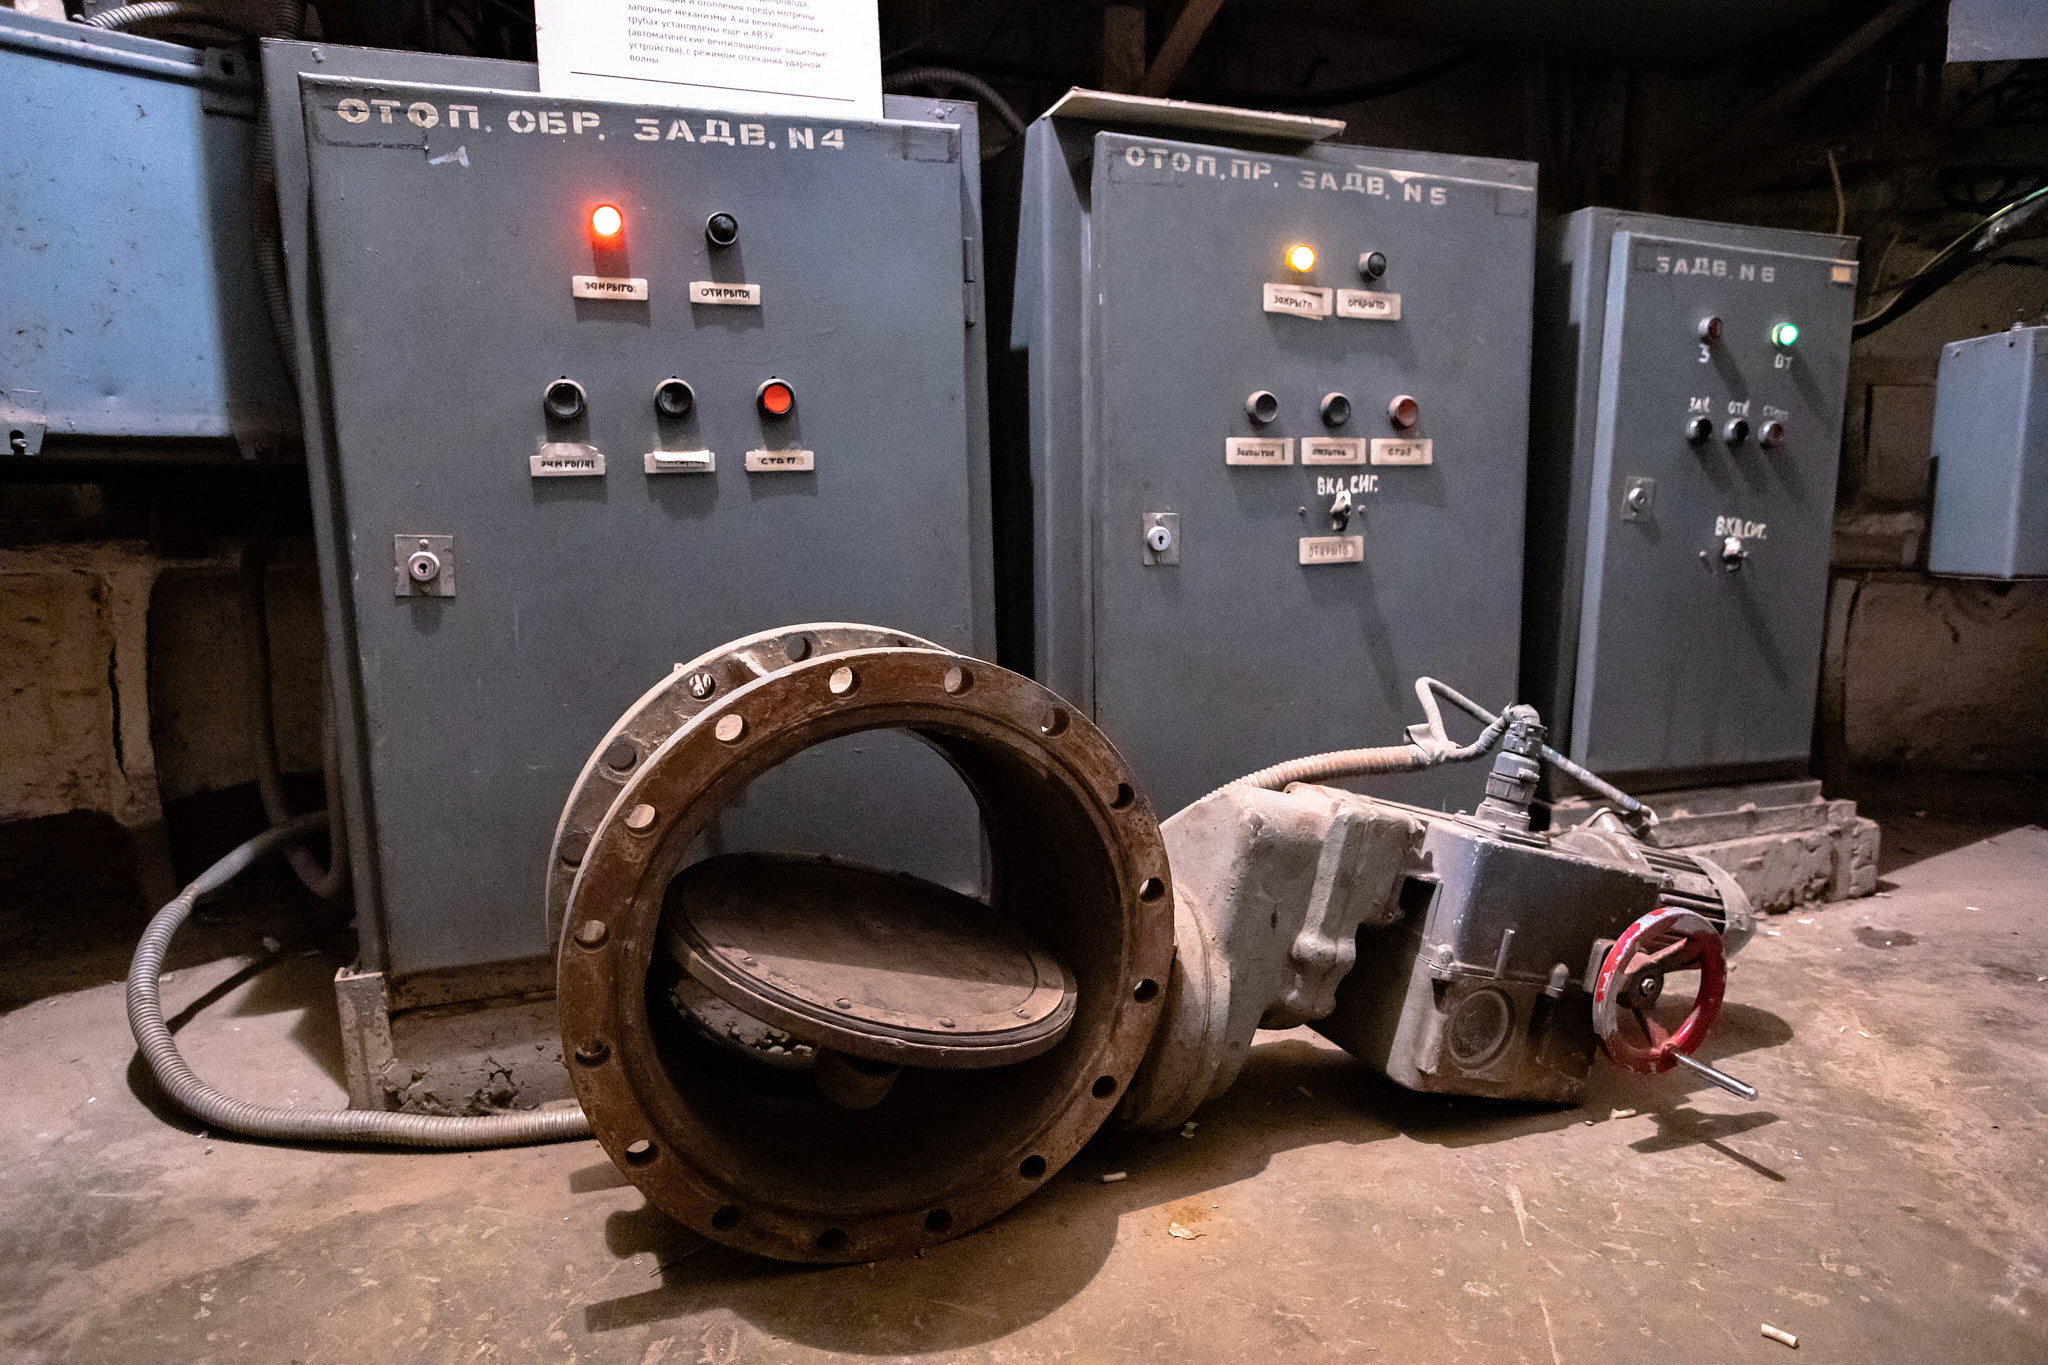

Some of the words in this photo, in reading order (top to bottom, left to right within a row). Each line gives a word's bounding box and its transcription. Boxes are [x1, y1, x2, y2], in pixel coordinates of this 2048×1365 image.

[628, 3, 673, 14] запорные
[752, 19, 825, 33] вентиляционных
[697, 0, 744, 11] отопления
[747, 6, 815, 20] предусмотрены
[628, 16, 659, 26] трубах
[662, 20, 720, 33] установлены
[722, 28, 741, 36] еще
[751, 30, 774, 39] АВЗУ
[628, 28, 705, 44] (автоматические
[707, 38, 782, 53] вентиляционные
[785, 47, 827, 58] защитные
[693, 48, 736, 60] режимом
[738, 54, 783, 65] отсекания
[785, 59, 822, 69] ударной
[337, 98, 492, 134] ОТОП.
[507, 110, 605, 141] ОБР.
[633, 118, 776, 150] ЗАДВ.
[1298, 170, 1391, 201] ЗАДВ.
[760, 457, 797, 465] СТОП
